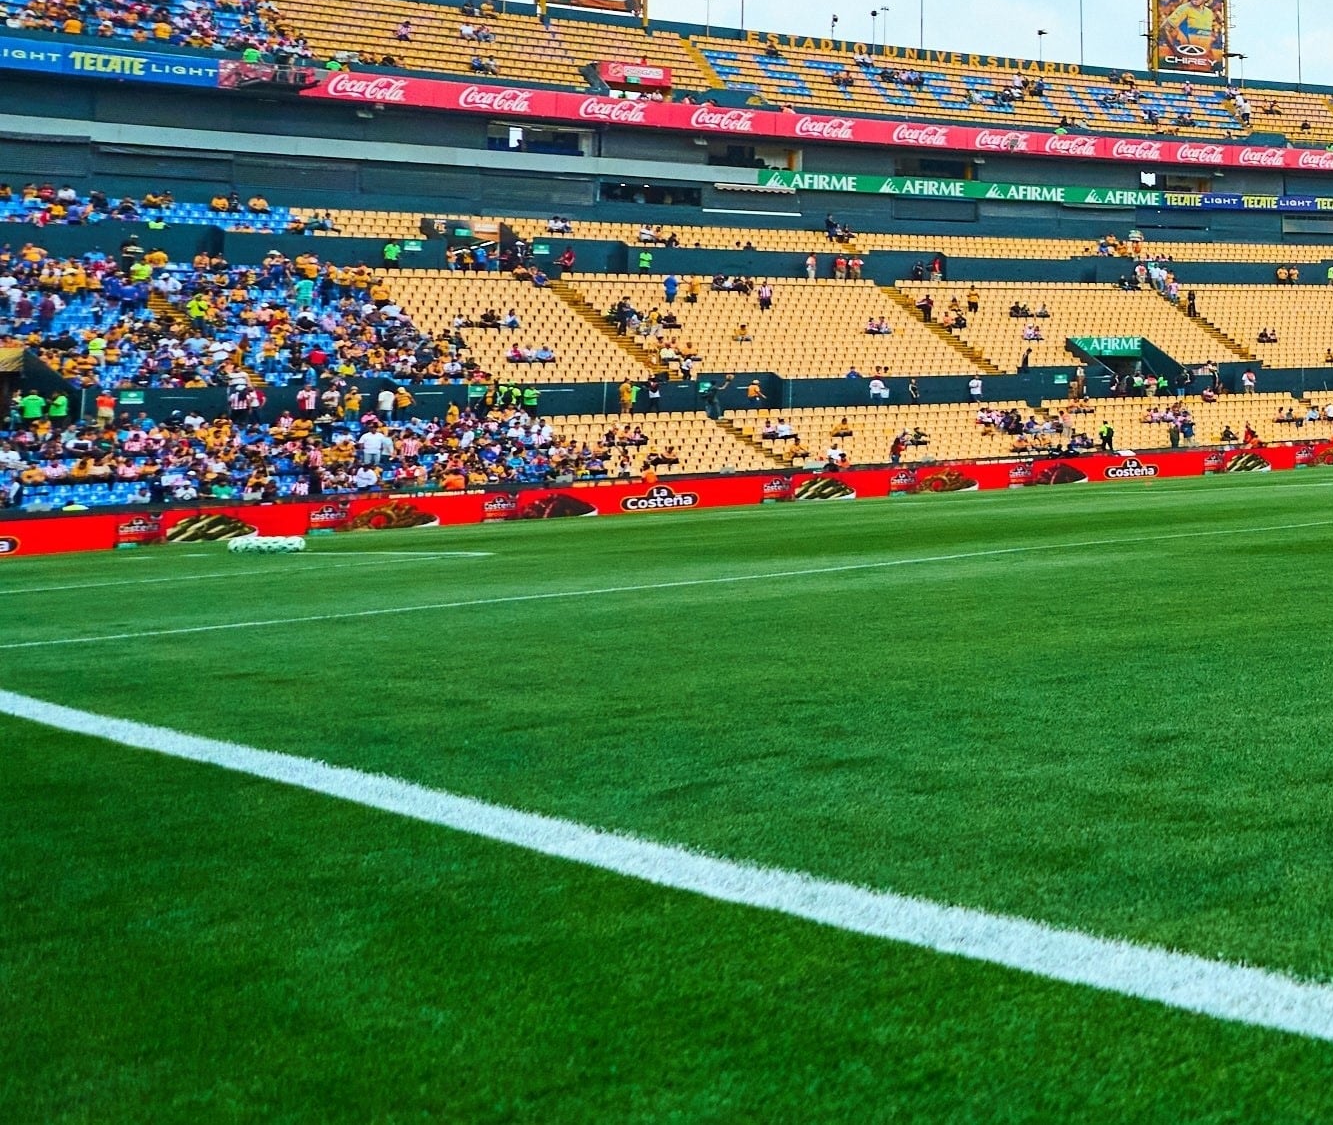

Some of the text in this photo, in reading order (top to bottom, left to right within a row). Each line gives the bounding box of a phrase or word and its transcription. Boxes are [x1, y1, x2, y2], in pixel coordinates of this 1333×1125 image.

[0, 49, 61, 62] IGHT
[747, 31, 1080, 75] ESTADIO UNIVERSITARIO
[69, 52, 217, 78] TECATE LIGHT
[1165, 56, 1217, 67] CHIREY
[791, 174, 857, 192] AFIRME
[902, 180, 965, 196] AFIRME
[1008, 186, 1065, 202] AFIRME
[1104, 191, 1159, 205] AFIRME
[1164, 193, 1238, 206] TECATE LIGHT
[1242, 196, 1312, 209] TECATE LIGHT
[1089, 337, 1141, 352] AFIRME
[1127, 460, 1137, 468] La
[1108, 466, 1154, 478] Costeña
[653, 486, 667, 497] La
[627, 494, 693, 511] Costeña
